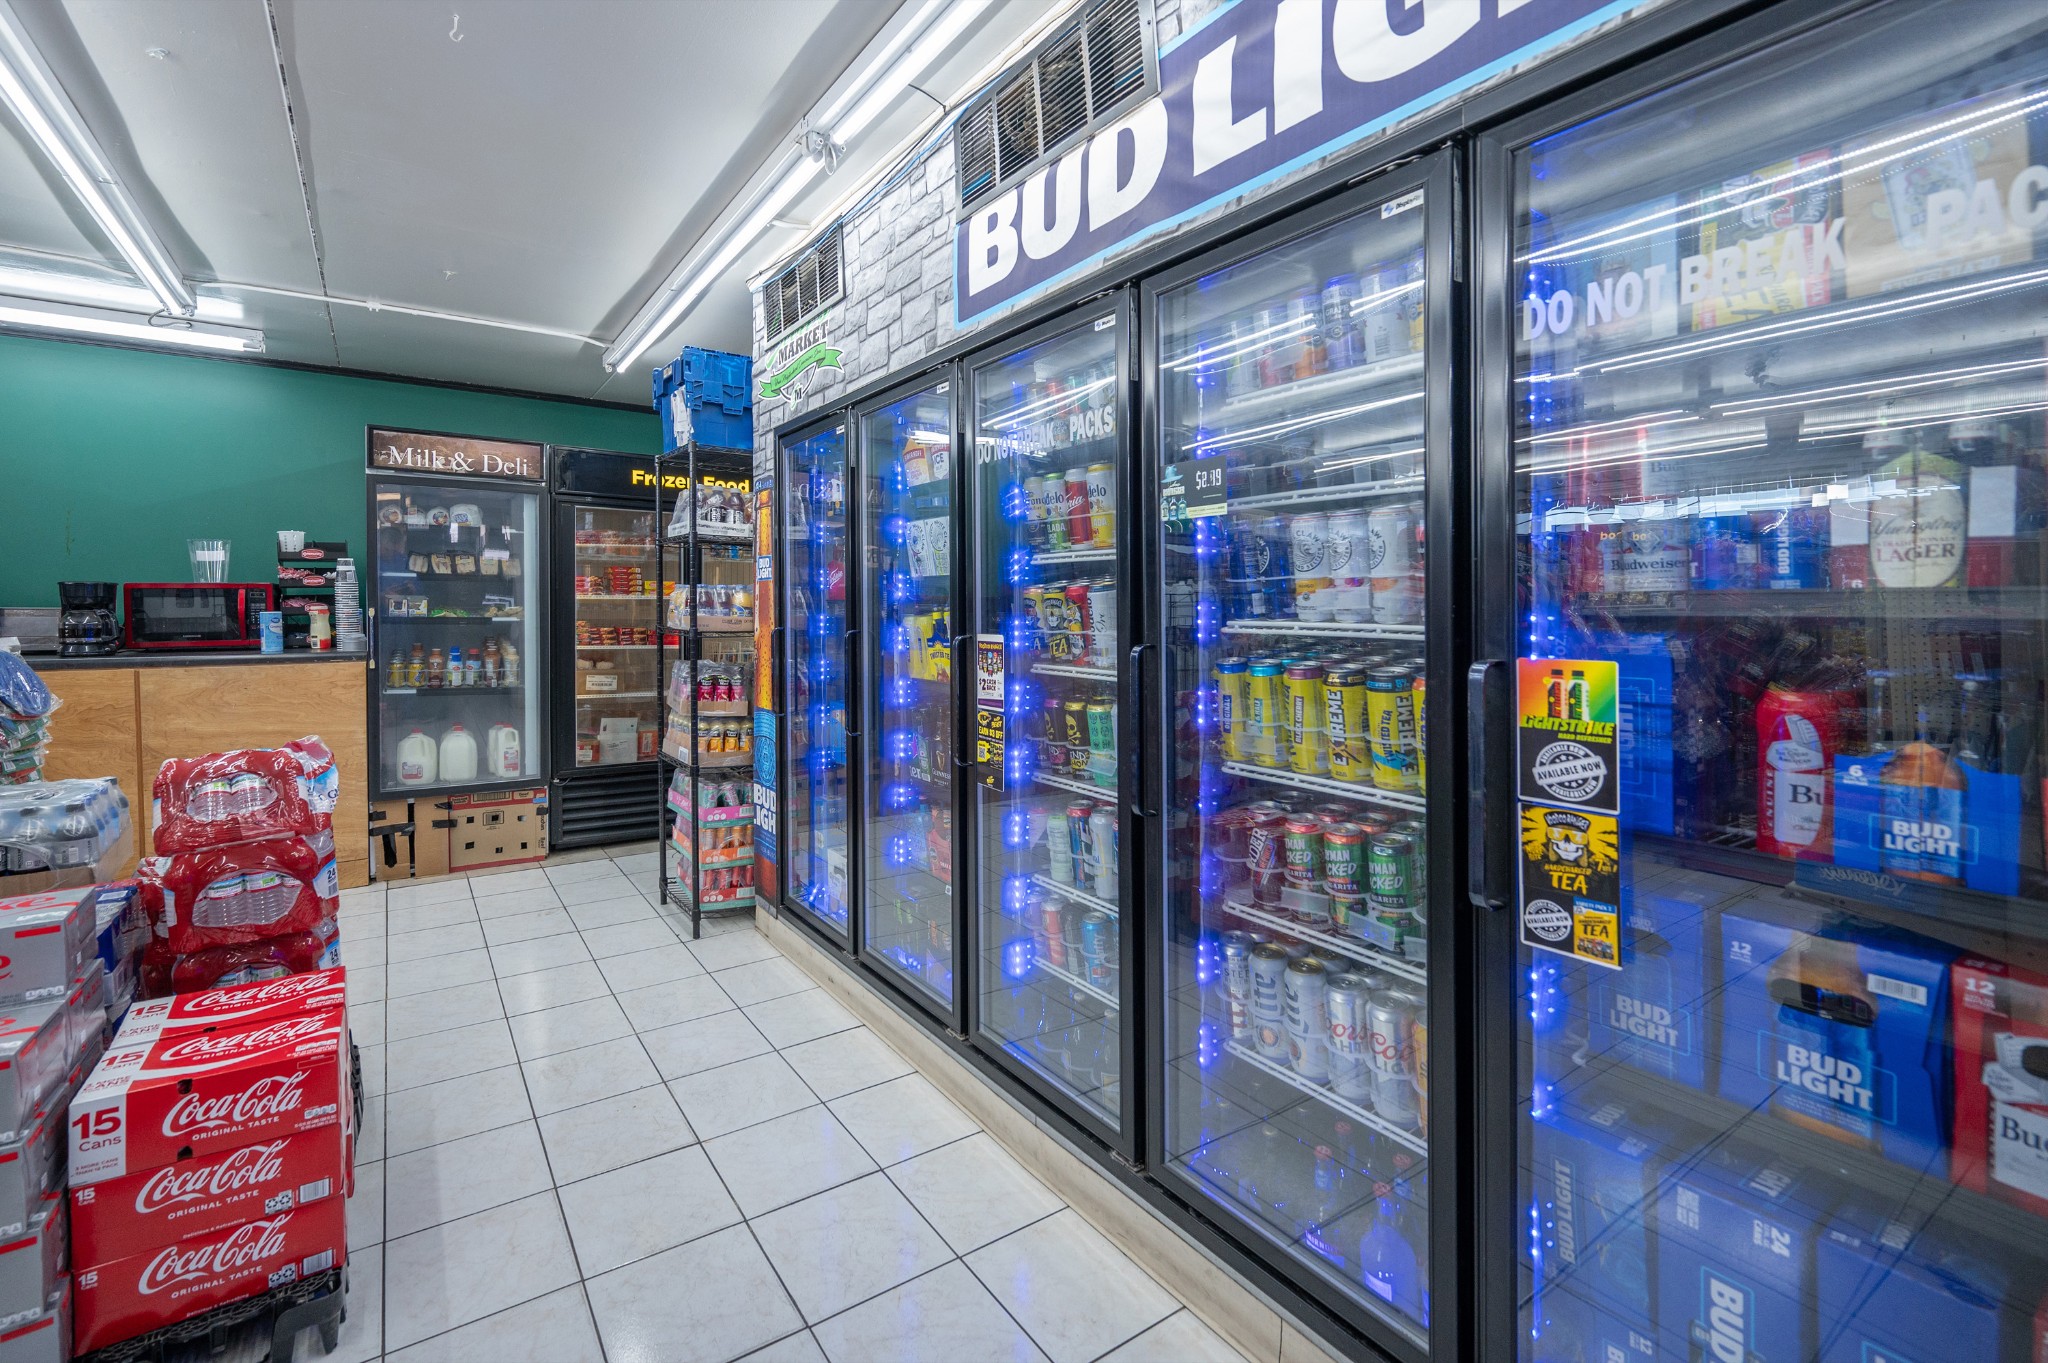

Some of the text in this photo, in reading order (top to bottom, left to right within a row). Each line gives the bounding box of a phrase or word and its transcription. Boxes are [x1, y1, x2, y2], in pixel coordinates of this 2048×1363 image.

[968, 0, 1542, 297] BUD LIG
[1523, 290, 1573, 341] DO
[1587, 265, 1666, 326] NOT
[1681, 216, 1846, 306] BREAK
[779, 321, 828, 365] MARKET
[1070, 405, 1114, 441] PACKS
[388, 446, 528, 476] Milk & Deli
[1611, 558, 1687, 572] Budweiser
[1877, 544, 1955, 562] LAGER
[1050, 638, 1067, 656] TEA
[1381, 710, 1393, 725] TEA
[1537, 761, 1602, 781] AVAILABLE NOW
[1849, 764, 1863, 777] 6
[1892, 819, 1953, 840] BUD
[1884, 833, 1961, 858] LIGHT
[327, 867, 336, 880] 24
[1549, 872, 1588, 895] TEA
[1527, 915, 1570, 925] AVAILABLE NOW
[1582, 923, 1610, 938] TEA
[330, 948, 338, 961] 24
[1730, 940, 1752, 956] 12
[183, 969, 339, 1012] Coca-Cola
[1965, 977, 1997, 996] 12
[129, 1003, 169, 1017] 15
[212, 990, 306, 1012] ORIGINAL TASTE
[1616, 994, 1671, 1025] BUD
[160, 1011, 336, 1062] Coca-Cola
[1610, 1009, 1679, 1047] LIGHT
[100, 1050, 145, 1067] 15
[192, 1037, 296, 1061] ORIGINAL TASTE
[1787, 1043, 1863, 1085] BUD
[1777, 1060, 1874, 1112] LIGHT
[161, 1069, 312, 1138] Coca-Cola
[72, 1107, 122, 1140] 15
[191, 1124, 245, 1141] ORIGINAL
[247, 1115, 280, 1129] TASTE
[79, 1135, 122, 1152] Cans
[135, 1138, 291, 1215] Coca-Cola
[76, 1187, 96, 1201] 15
[167, 1189, 260, 1220] ORIGINAL TASTE
[1555, 1160, 1577, 1265] BUD LIGHT
[137, 1211, 295, 1296] Coca-Cola
[1771, 1226, 1792, 1258] 24
[78, 1271, 99, 1286] 15
[171, 1265, 263, 1299] ORIGINAL TASTE
[1710, 1276, 1744, 1363] BUD
